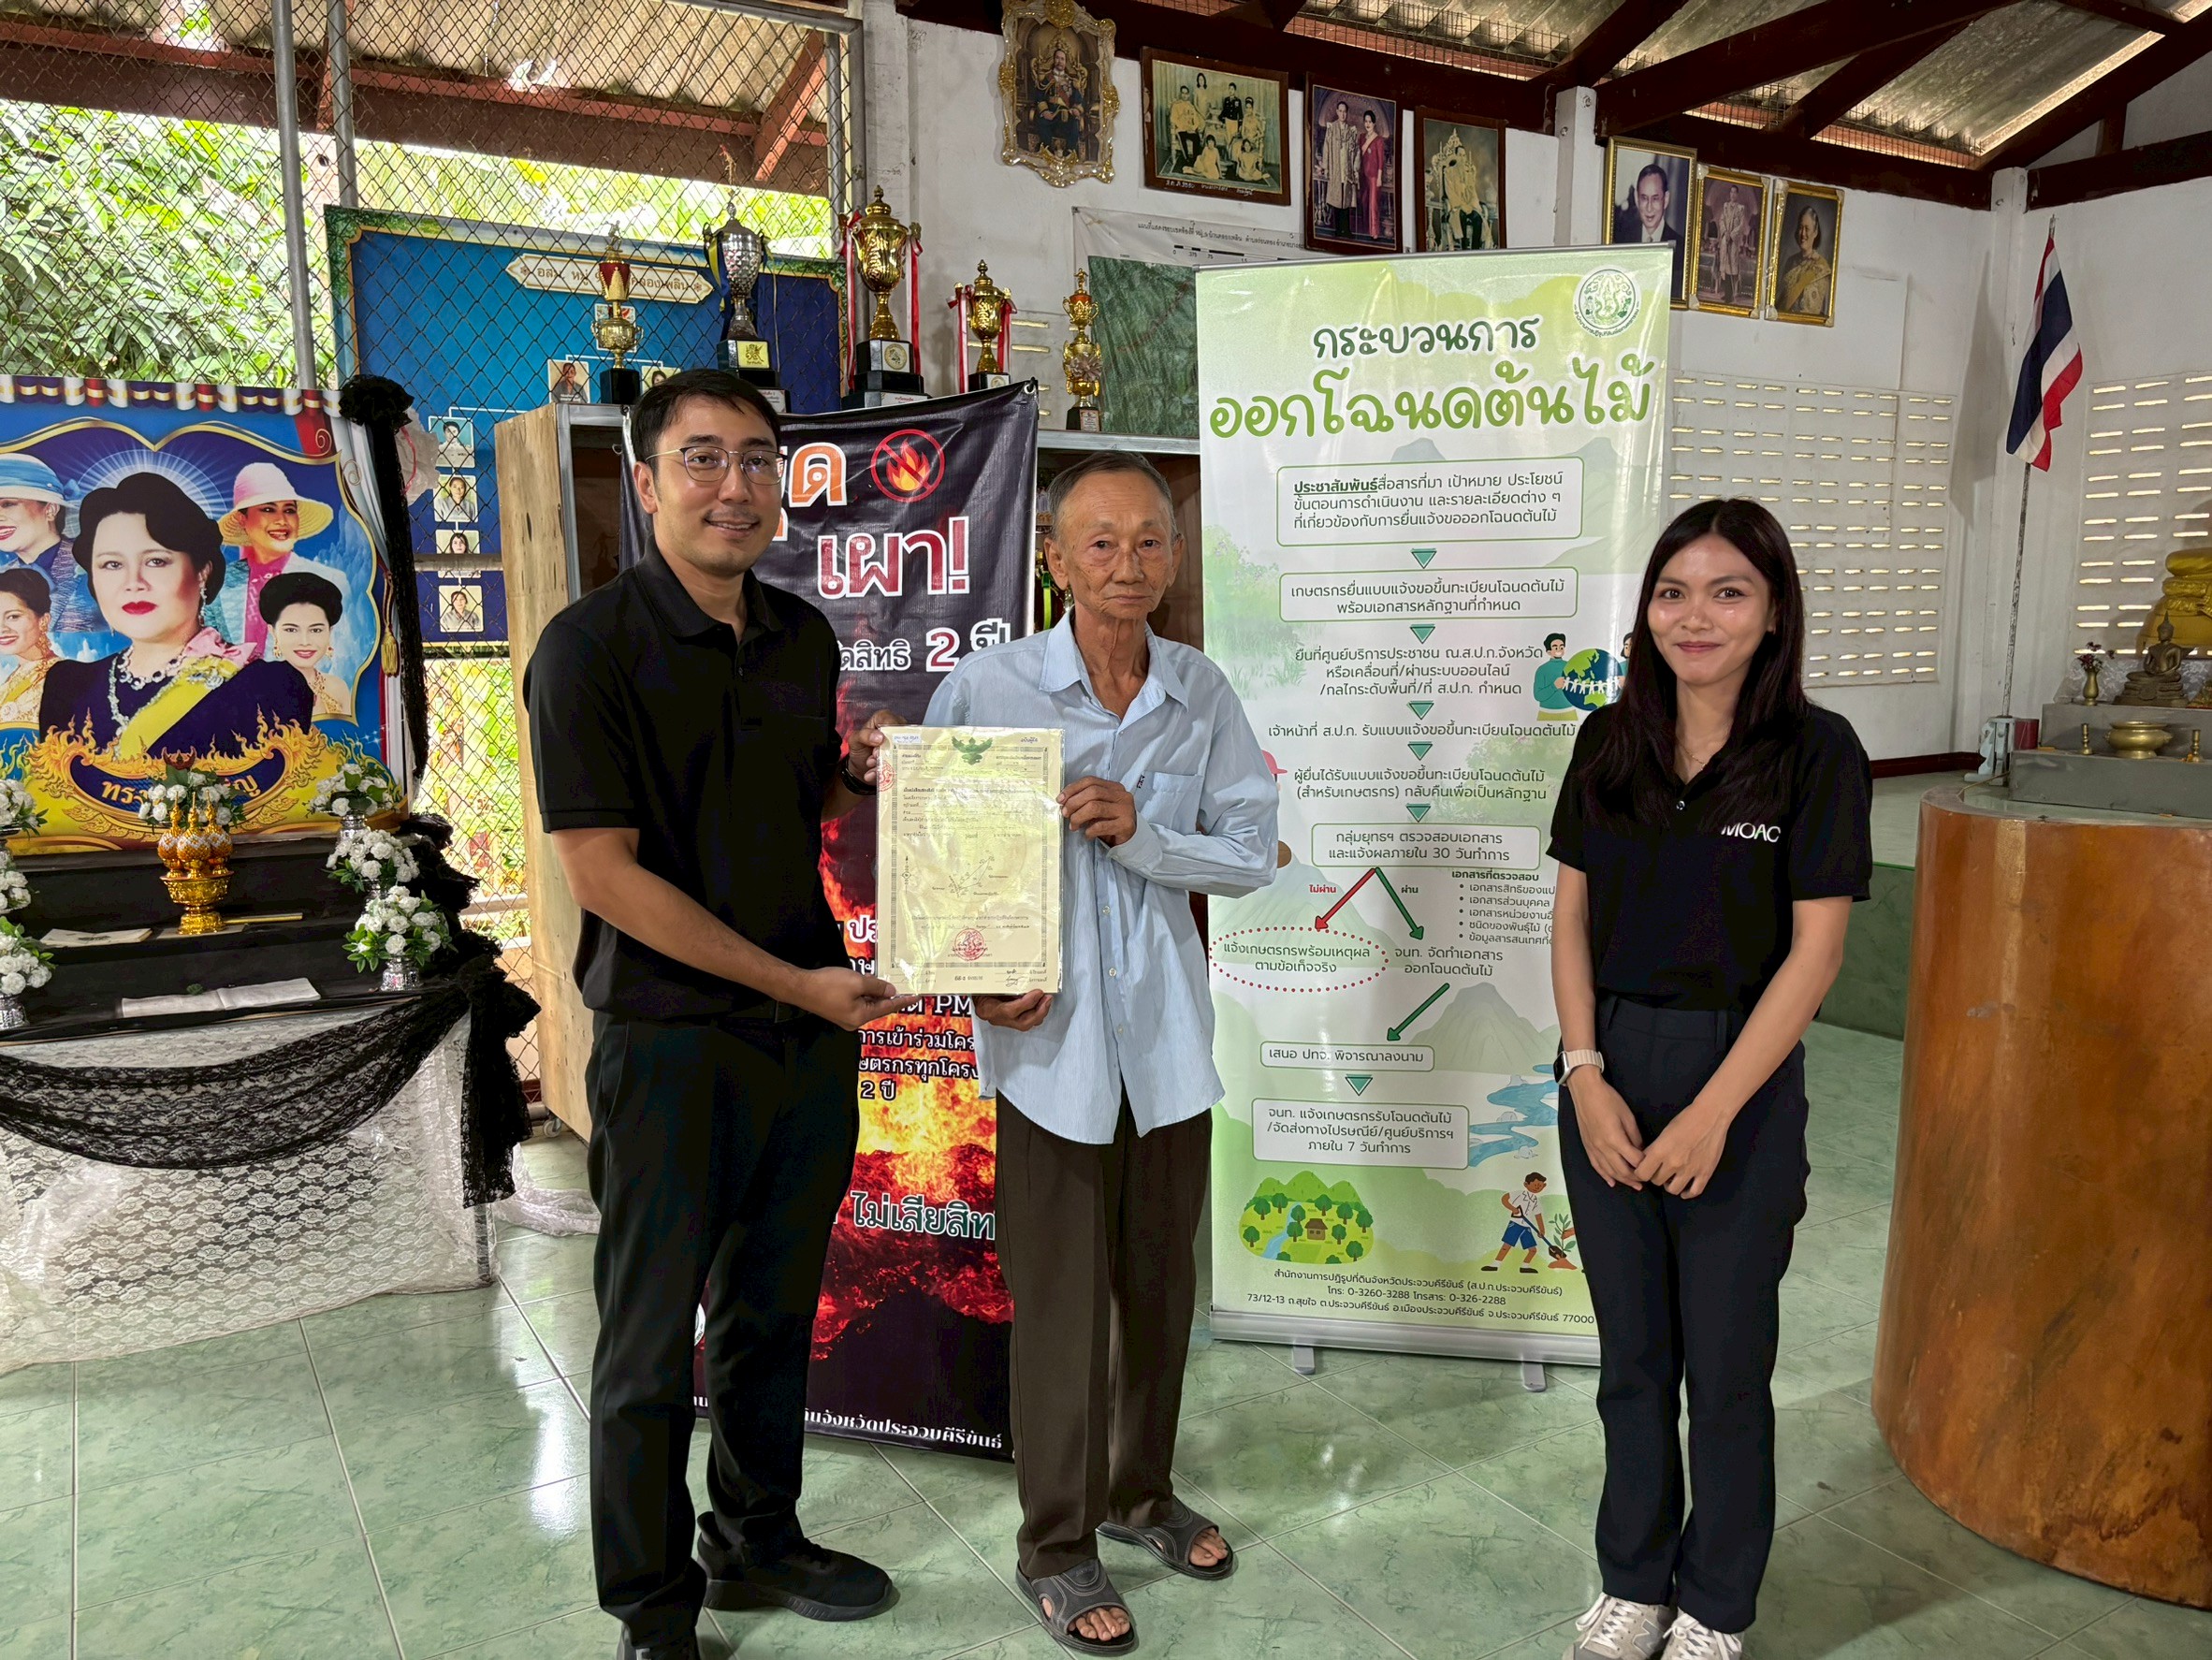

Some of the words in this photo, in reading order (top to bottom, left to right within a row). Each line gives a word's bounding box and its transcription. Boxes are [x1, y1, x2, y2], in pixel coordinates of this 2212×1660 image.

[1313, 317, 1540, 358] กระบวนการ
[1209, 353, 1655, 439] ออกโฉนดต้นไม้
[1448, 473, 1502, 488] เป้าหมาย
[1507, 471, 1564, 486] ประโยชน์
[1293, 494, 1423, 510] ขั้นตอนการดำเนินงาน
[1429, 490, 1546, 506] และรายละเอียดต่าง
[1293, 508, 1557, 529] ที่เกี่ยวข้องกับการยื่นแจ้งขอออกโฉนดต้นไม้
[817, 516, 970, 600] เผา!
[1291, 576, 1565, 597] เกษตรกรยื่นแบบแจ้งขอขึ้นทะเบียนโฉนดต้นไม้
[1336, 595, 1521, 614] พร้อมเอกสารหลักฐานที่กำหนด
[925, 627, 961, 673] 2
[1326, 661, 1511, 678] หรือเคลื่อนที่/ผ่านระบบออนไลน์
[1437, 681, 1473, 694] ส.ป.ก.
[1478, 680, 1522, 694] กำหนด
[1268, 721, 1318, 736] เจ้าหน้าที่
[1322, 725, 1358, 736] ส.ป.ก.
[1362, 720, 1577, 736] รับแบบแจ้งขอขึ้นทะเบียนโฉนดต้นไม้
[1294, 764, 1546, 784] ผู้ยื่นได้รับแบบแจ้งขอขึ้นทะเบียนโฉนดต้นไม้
[1297, 784, 1400, 799] (สำหรับเกษตรกร)
[1404, 782, 1547, 802] กลับคืนเพื่อเป็นหลักฐาน
[1336, 830, 1394, 846] กลุ่มยุทธฯ
[1399, 832, 1503, 844] ตรวจสอบเอกสาร
[1721, 822, 1782, 843] MOAC
[1329, 847, 1428, 859] และแจ้งผลภายใน
[1433, 847, 1450, 859] 30
[1456, 847, 1510, 860] วันทำการ
[1451, 867, 1539, 881] เอกสารที่ตรวจสอบ
[1309, 884, 1337, 894] ไม่ผ่าน
[1401, 885, 1419, 894] ผ่าน
[1469, 896, 1550, 909] เอกสารส่วนบุคคล
[1224, 941, 1371, 960] แจ้งเกษตรกรพร้อมเหตุผล
[1394, 948, 1422, 957] จนท.
[1428, 946, 1504, 961] จัดทำเอกสาร
[1255, 959, 1337, 973] ตามข้อเท็จจริง
[1404, 963, 1493, 976] ออกโฉนดต้นไม้
[1269, 1049, 1298, 1058] เสนอ
[1335, 1050, 1424, 1062] พิจารณาลงนาม
[861, 1081, 876, 1099] 2
[880, 1079, 895, 1100] ปี
[1268, 1108, 1295, 1118] จนท.
[1300, 1107, 1452, 1123] แจ้งเกษตรกรรับโฉนดต้นไม้
[1308, 1140, 1343, 1152] ภายใน
[1348, 1141, 1355, 1152] 7
[1360, 1141, 1411, 1154] วันทำการ
[1327, 1286, 1345, 1295] โทร:
[1347, 1288, 1410, 1300] 0-3260-3288
[1413, 1291, 1446, 1302] โทรสาร:
[1448, 1293, 1506, 1305] 0-326-2288
[1247, 1293, 1285, 1304] 73/12-13
[1563, 1315, 1595, 1324] 77000
